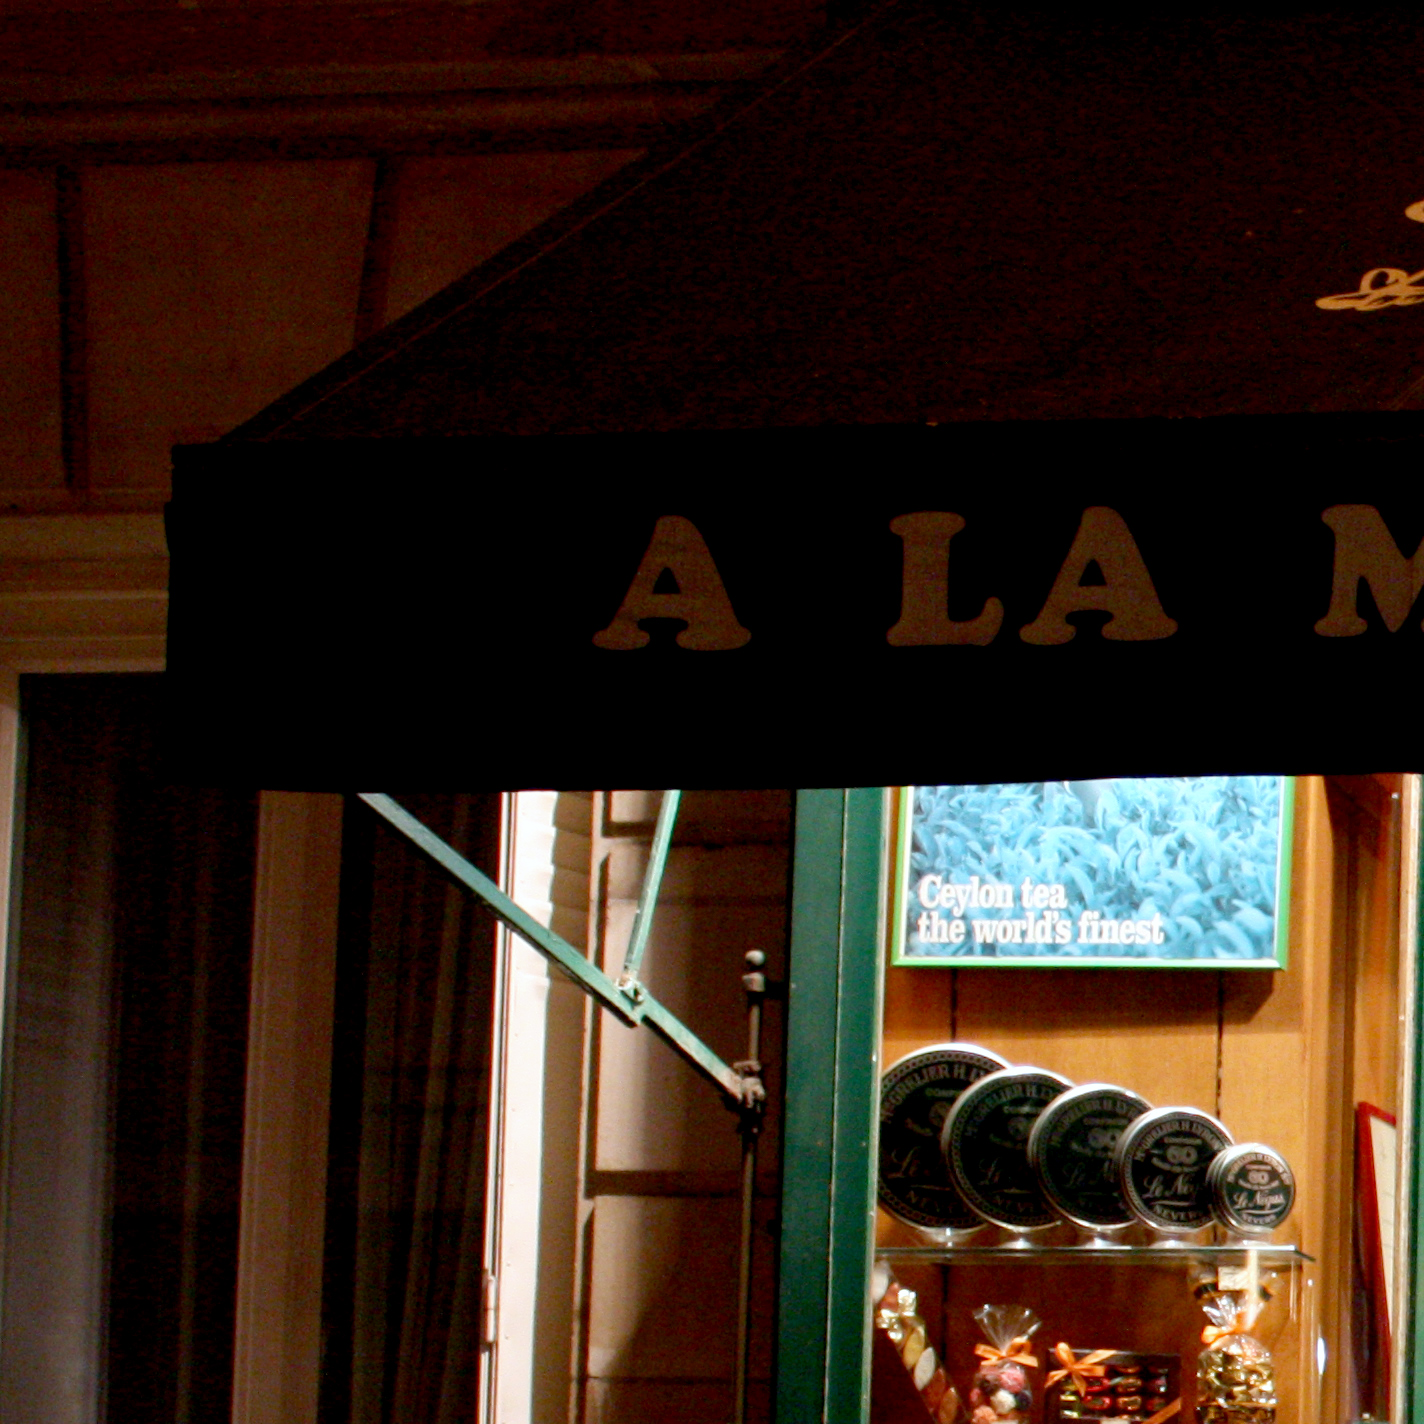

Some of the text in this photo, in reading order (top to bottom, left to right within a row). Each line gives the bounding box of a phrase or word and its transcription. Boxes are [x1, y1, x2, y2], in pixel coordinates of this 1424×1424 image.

[592, 515, 752, 651] A
[886, 506, 1178, 646] LA
[917, 873, 1069, 917] Ceylon tea
[917, 910, 1165, 945] the world's finest
